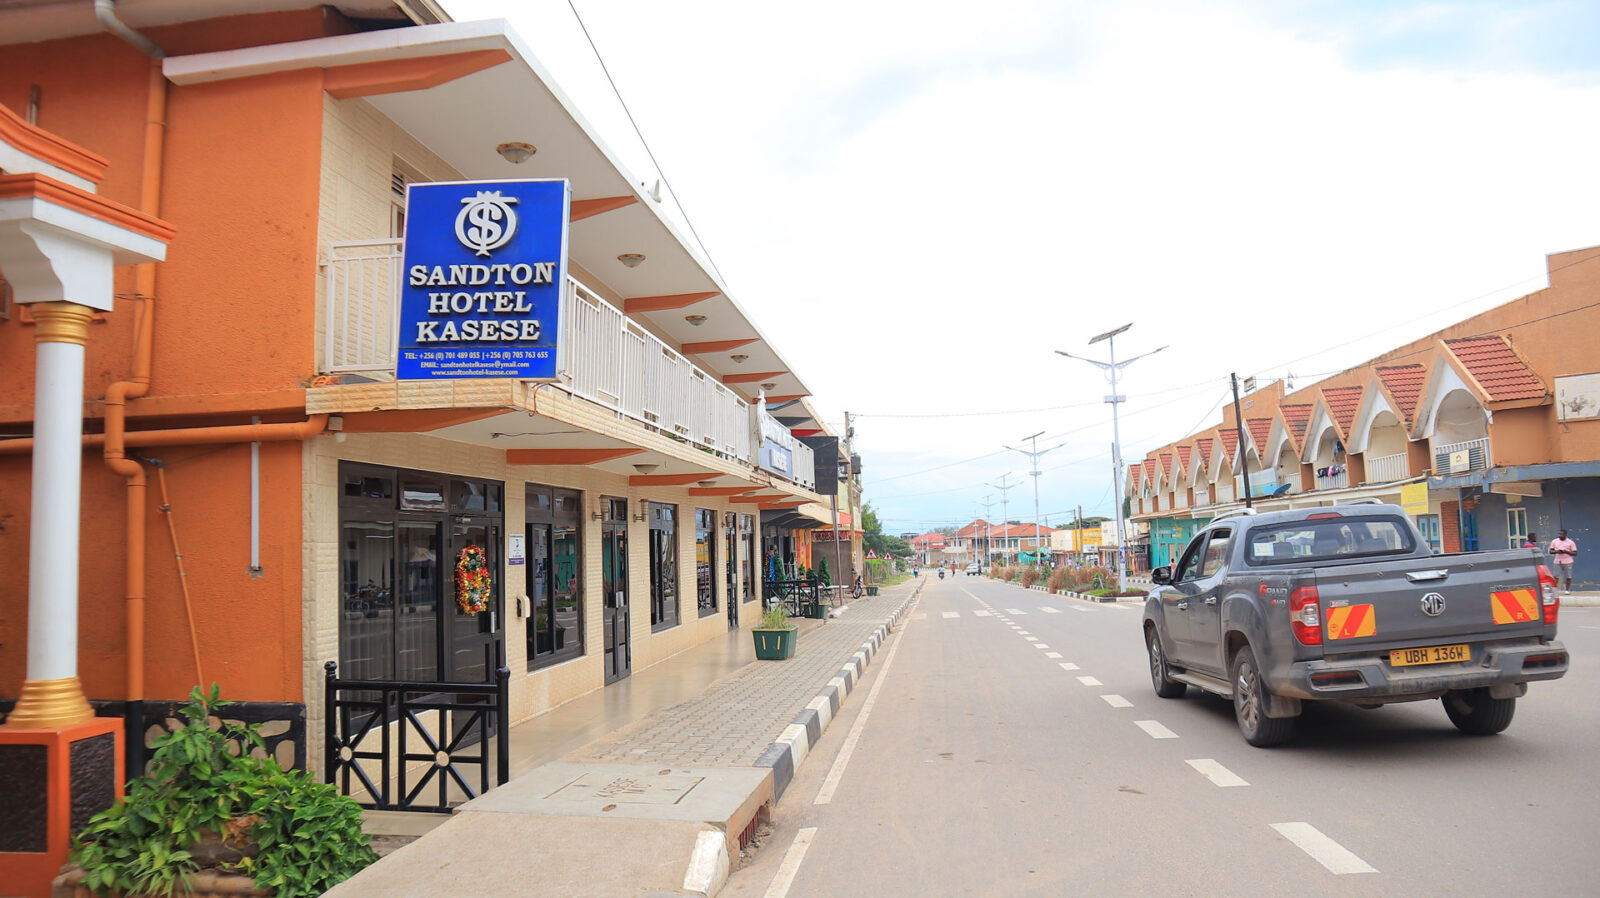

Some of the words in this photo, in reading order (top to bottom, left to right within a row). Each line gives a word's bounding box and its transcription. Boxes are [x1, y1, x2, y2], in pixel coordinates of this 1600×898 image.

[409, 262, 556, 286] SANDTON
[427, 291, 533, 313] HOTEL
[415, 319, 540, 342] KASESE
[404, 352, 418, 360] TEL:
[419, 352, 434, 360] +256
[435, 352, 444, 361] (0)
[445, 352, 456, 360] 701
[502, 352, 511, 361] (0)
[512, 351, 524, 359] 705
[525, 351, 536, 359] 763
[537, 351, 549, 359] 655
[1423, 594, 1445, 614] MG
[1516, 612, 1525, 620] R
[1344, 628, 1350, 636] L
[1404, 650, 1429, 664] UBH
[1430, 646, 1464, 662] 136W
